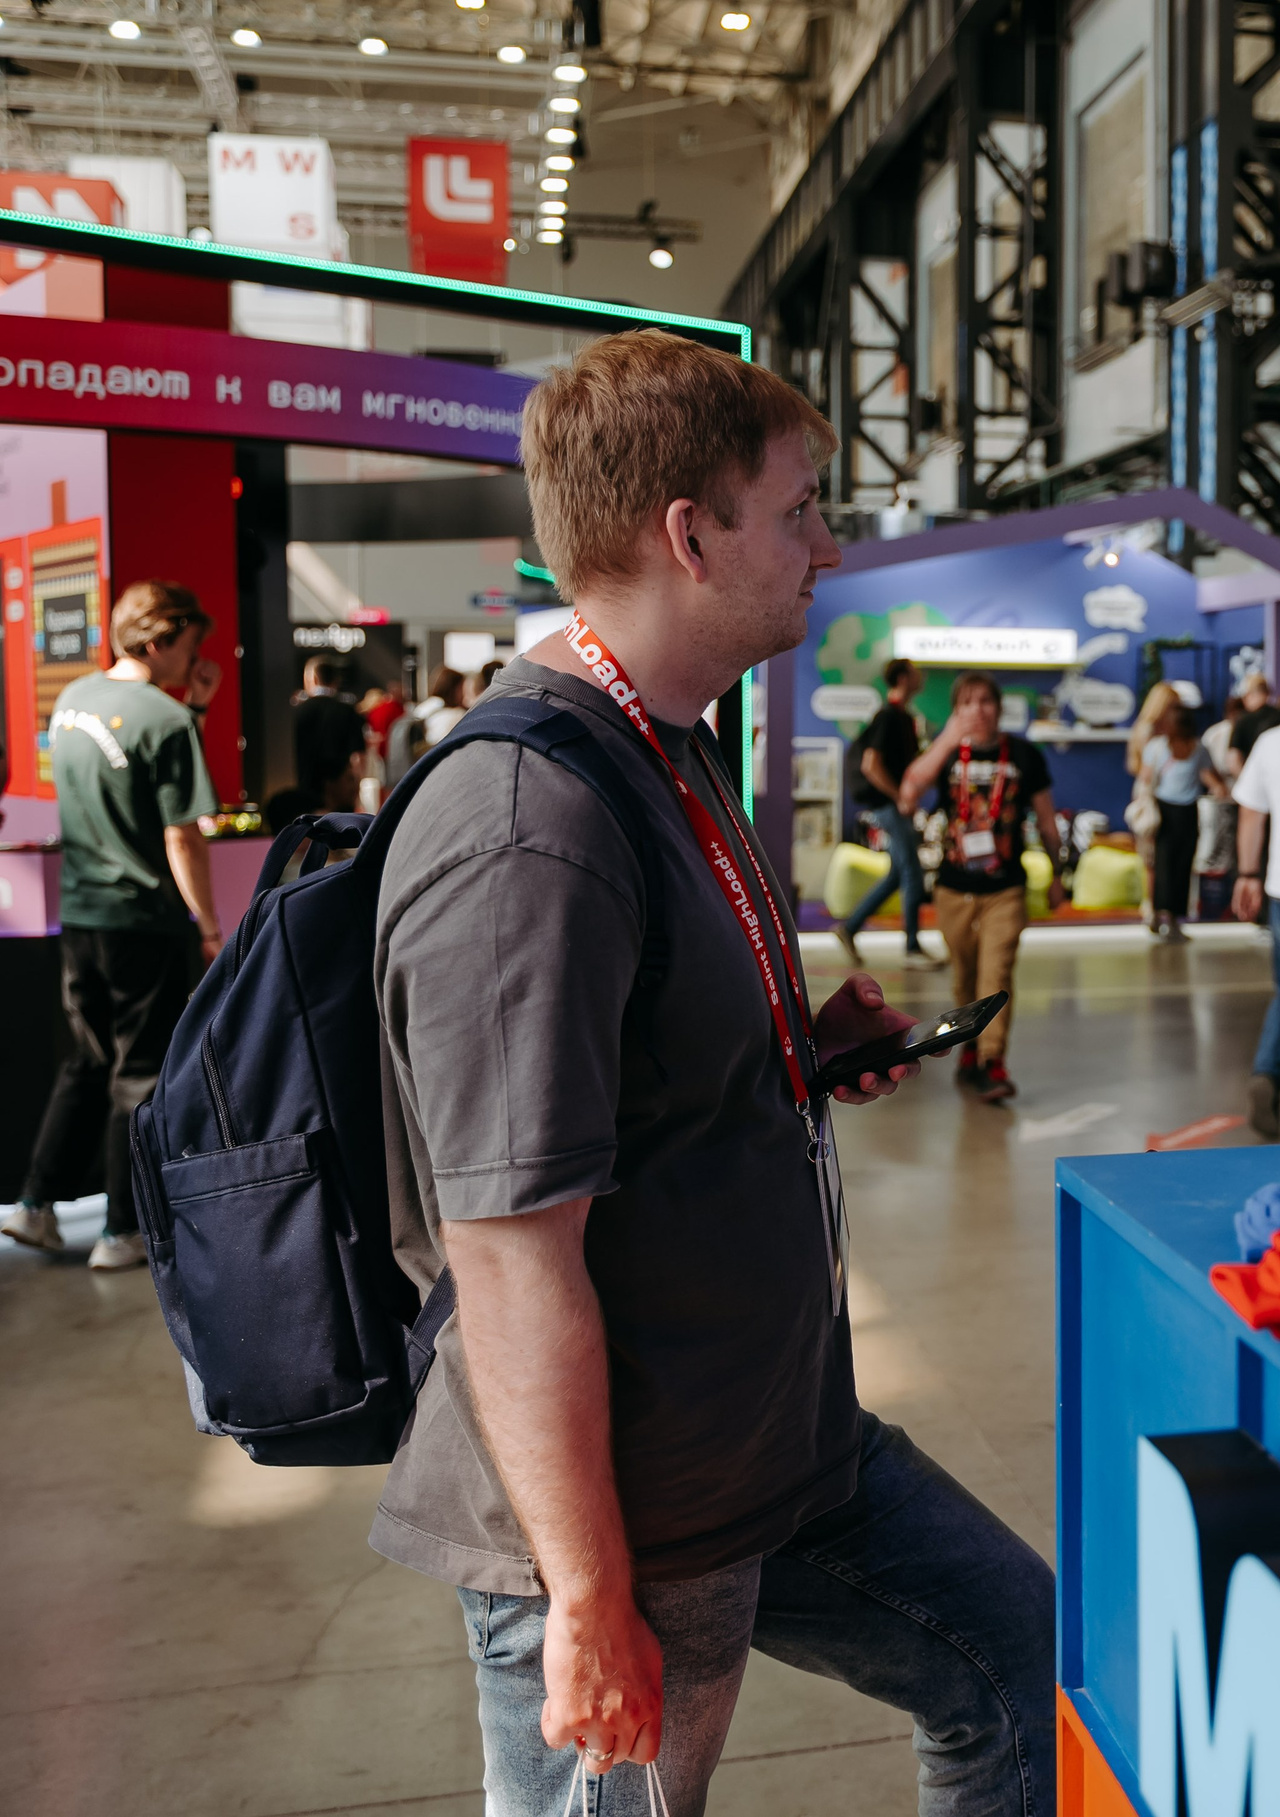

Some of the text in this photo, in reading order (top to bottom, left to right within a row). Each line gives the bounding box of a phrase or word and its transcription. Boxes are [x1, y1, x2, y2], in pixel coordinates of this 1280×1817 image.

[268, 379, 342, 414] вам
[563, 613, 651, 736] hLoad++
[710, 840, 764, 951] HighLoad++
[759, 950, 779, 1006] Saint
